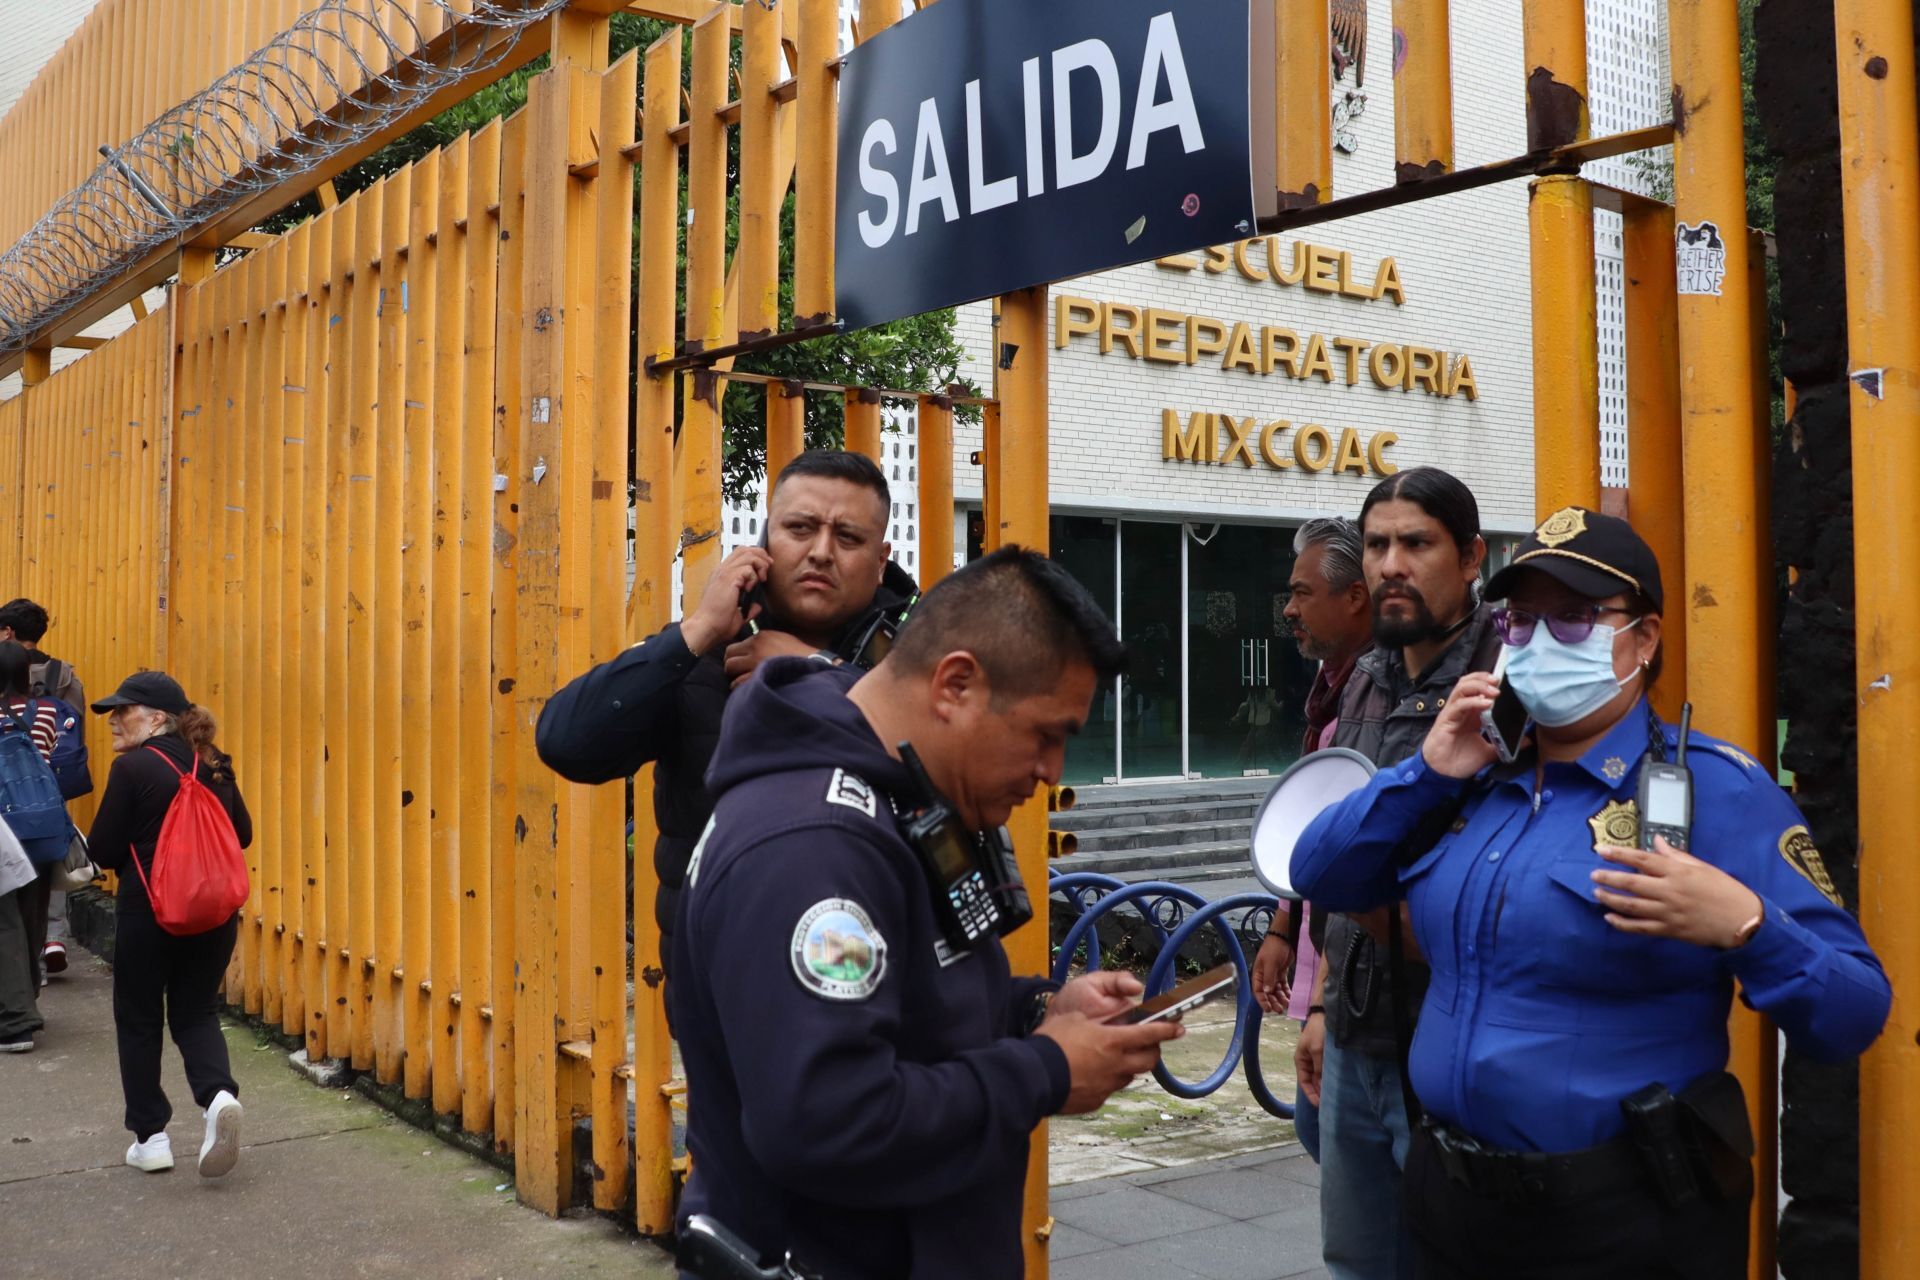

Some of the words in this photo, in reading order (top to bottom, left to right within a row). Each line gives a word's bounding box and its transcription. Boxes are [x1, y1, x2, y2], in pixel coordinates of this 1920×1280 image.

[857, 11, 1206, 249] SALIDA
[1677, 248, 1724, 270] GETHER
[1055, 294, 1478, 401] PREPARATORIA
[1161, 408, 1400, 477] MIXCOAC
